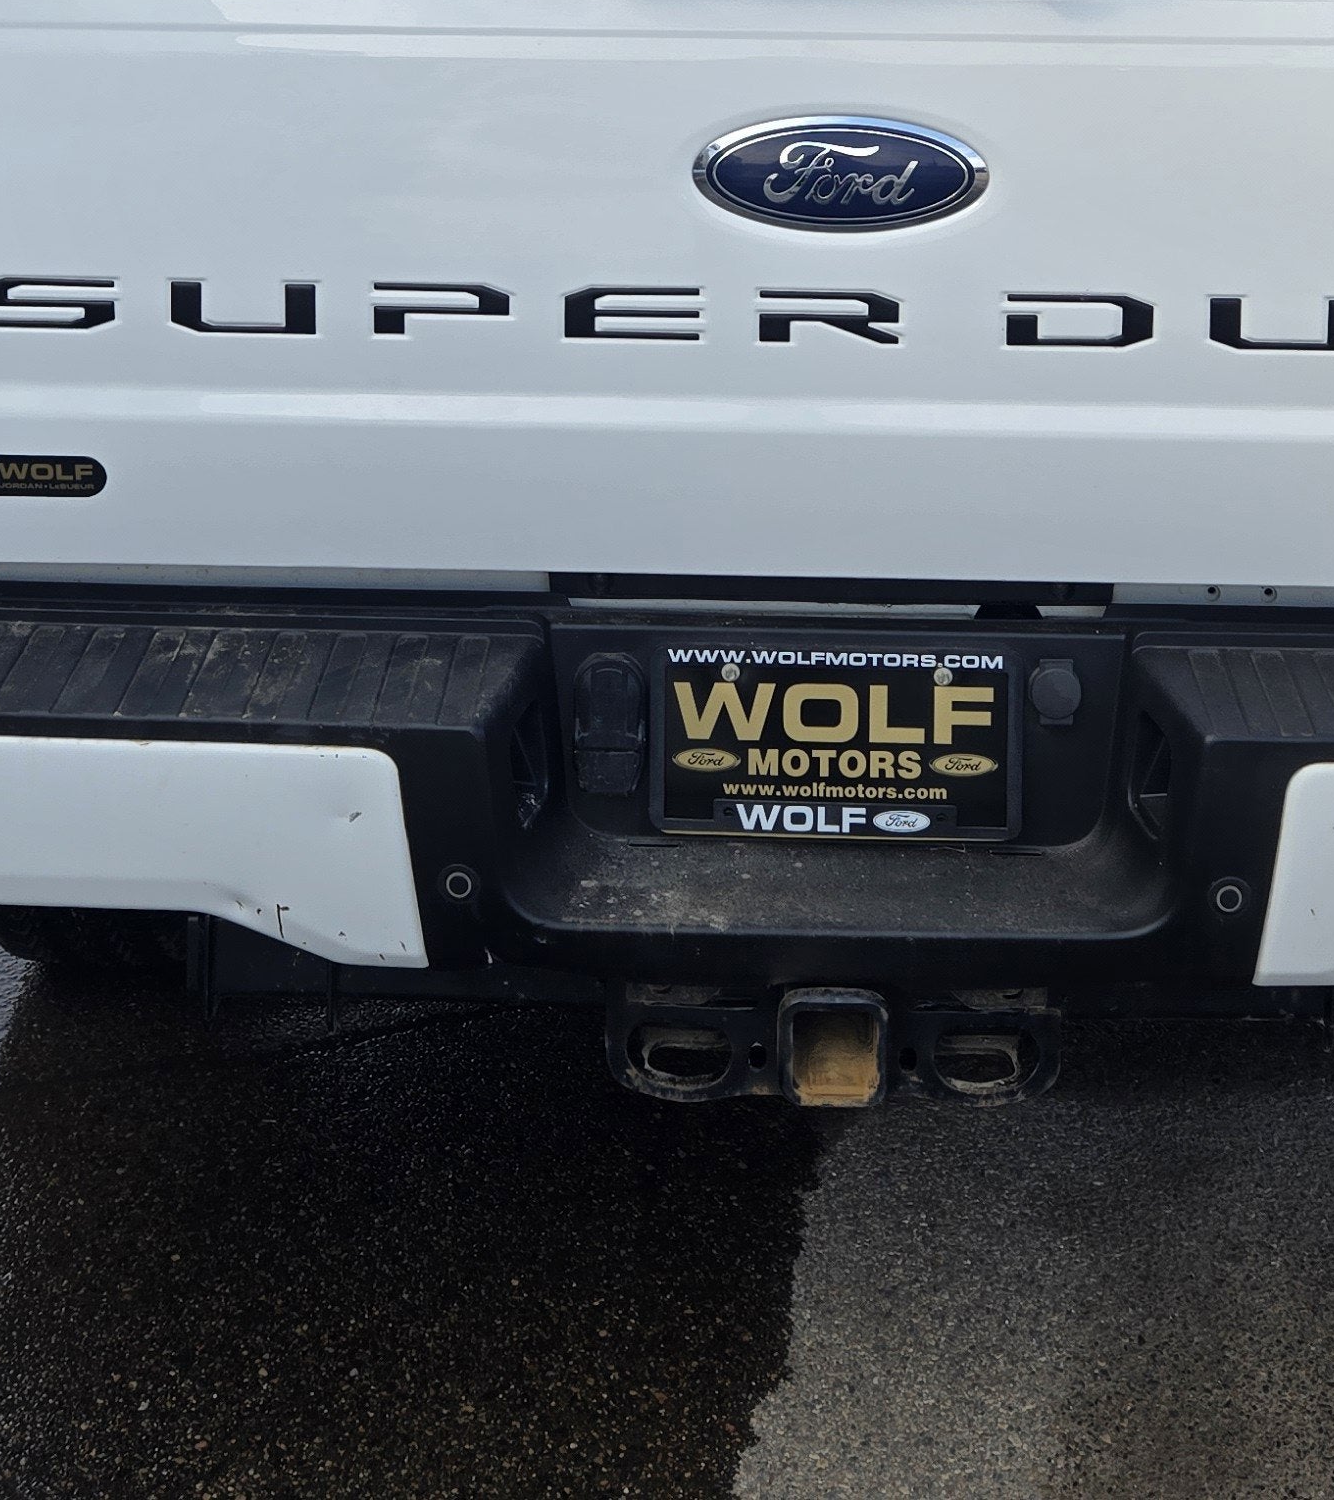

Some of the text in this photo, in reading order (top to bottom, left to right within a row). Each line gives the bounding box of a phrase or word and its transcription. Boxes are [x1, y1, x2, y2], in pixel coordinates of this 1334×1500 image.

[763, 140, 919, 205] Ford
[668, 649, 1003, 670] WWW.WOLFMOTORS.COM
[673, 681, 995, 745] WOLF
[747, 748, 922, 779] MOTORS
[723, 782, 948, 800] www.wolfmotors.com
[736, 803, 867, 833] WOLF
